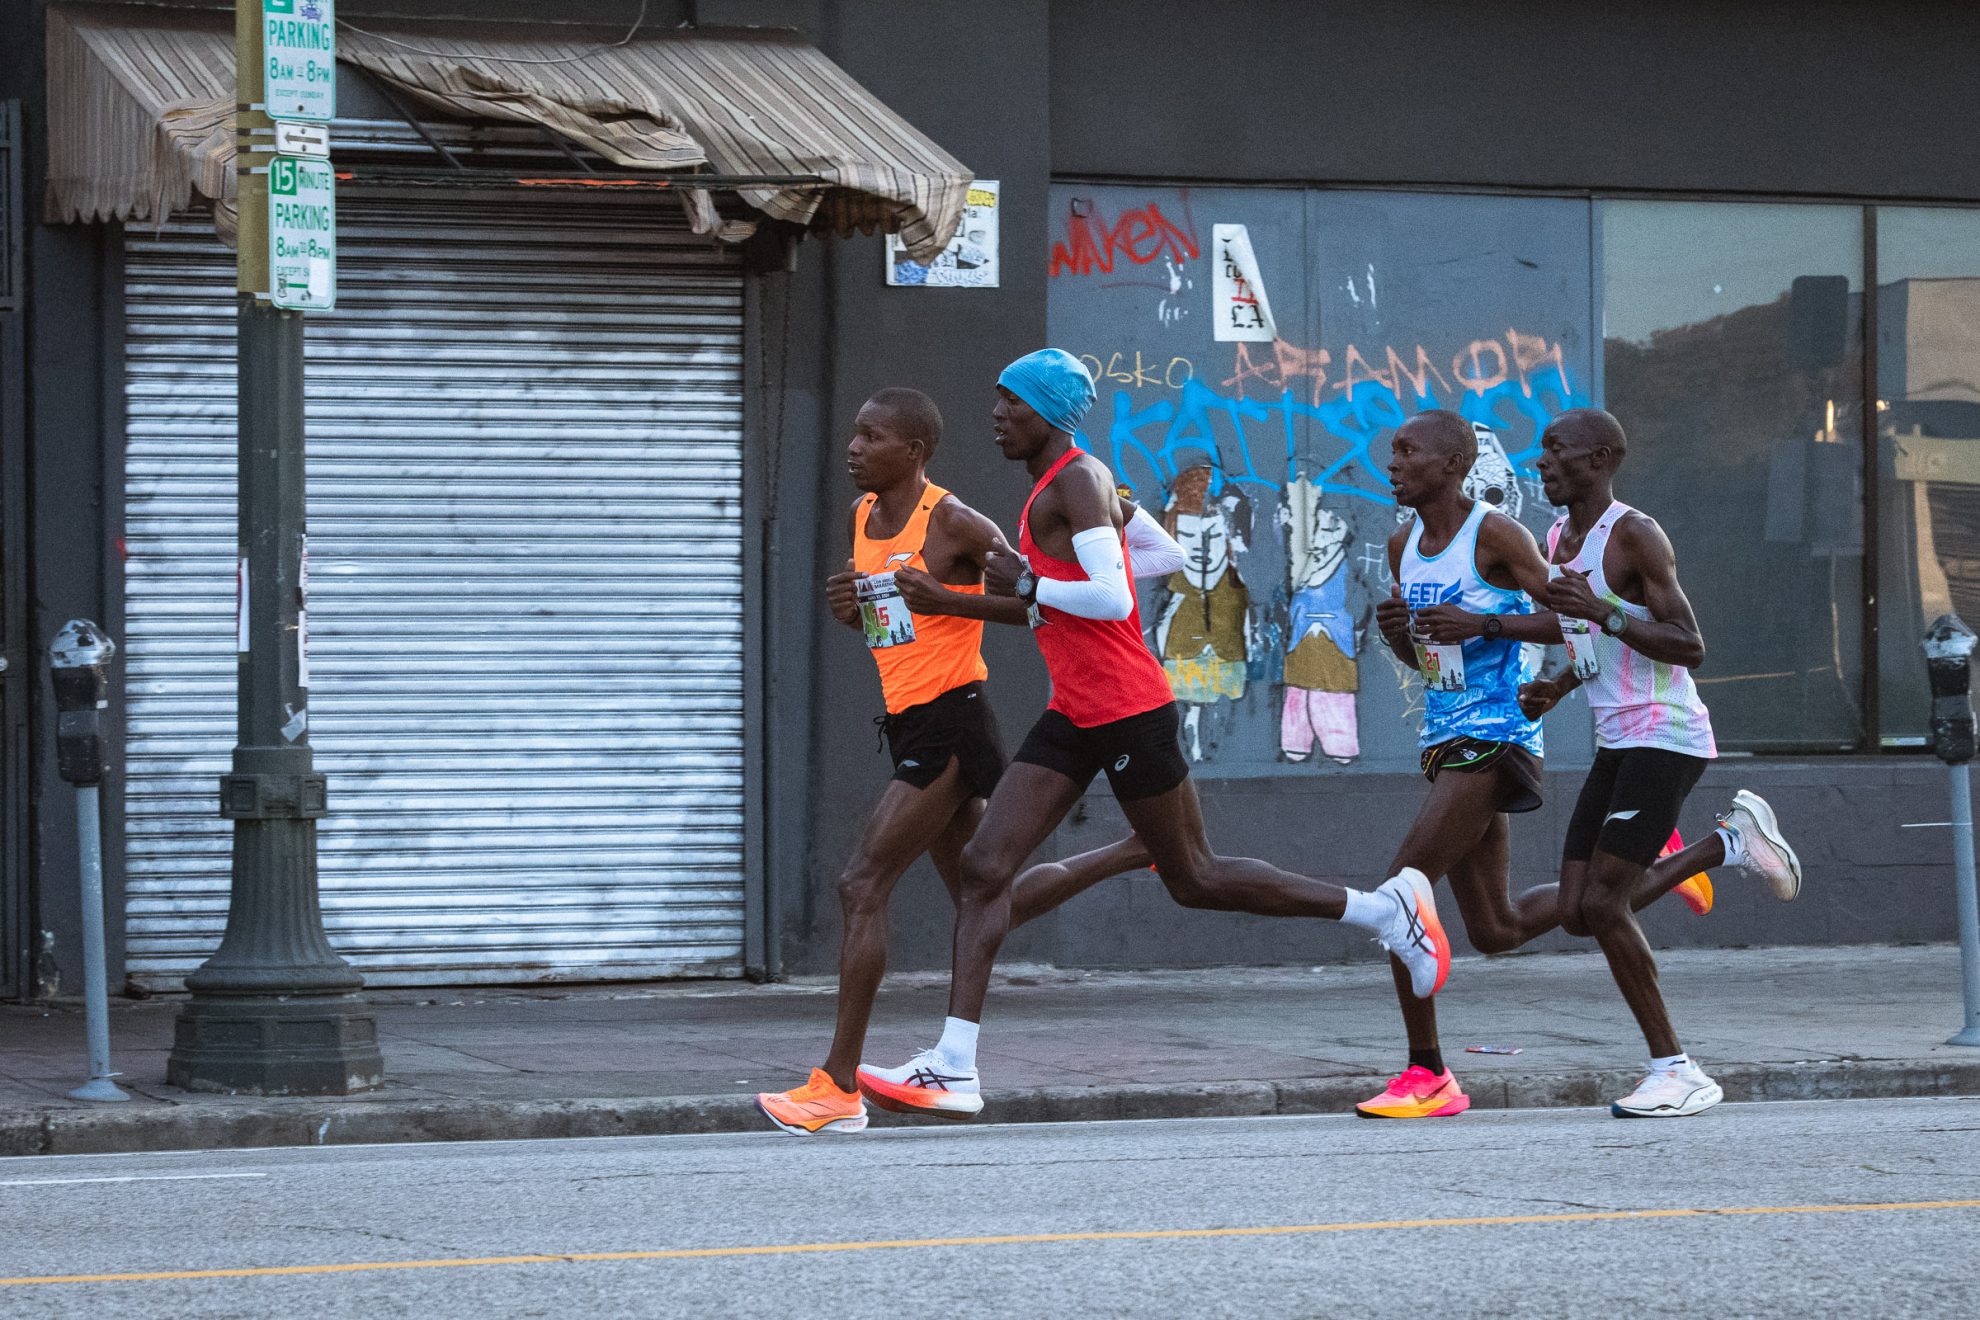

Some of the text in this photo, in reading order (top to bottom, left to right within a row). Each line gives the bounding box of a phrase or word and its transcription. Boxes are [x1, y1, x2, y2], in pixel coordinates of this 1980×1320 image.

[269, 19, 330, 51] PARKING
[274, 161, 329, 192] 15 MINUTE
[275, 202, 330, 231] PARKING
[275, 236, 298, 258] 8AM
[307, 238, 331, 260] 8PM
[872, 606, 890, 627] 15
[1424, 652, 1441, 672] 21
